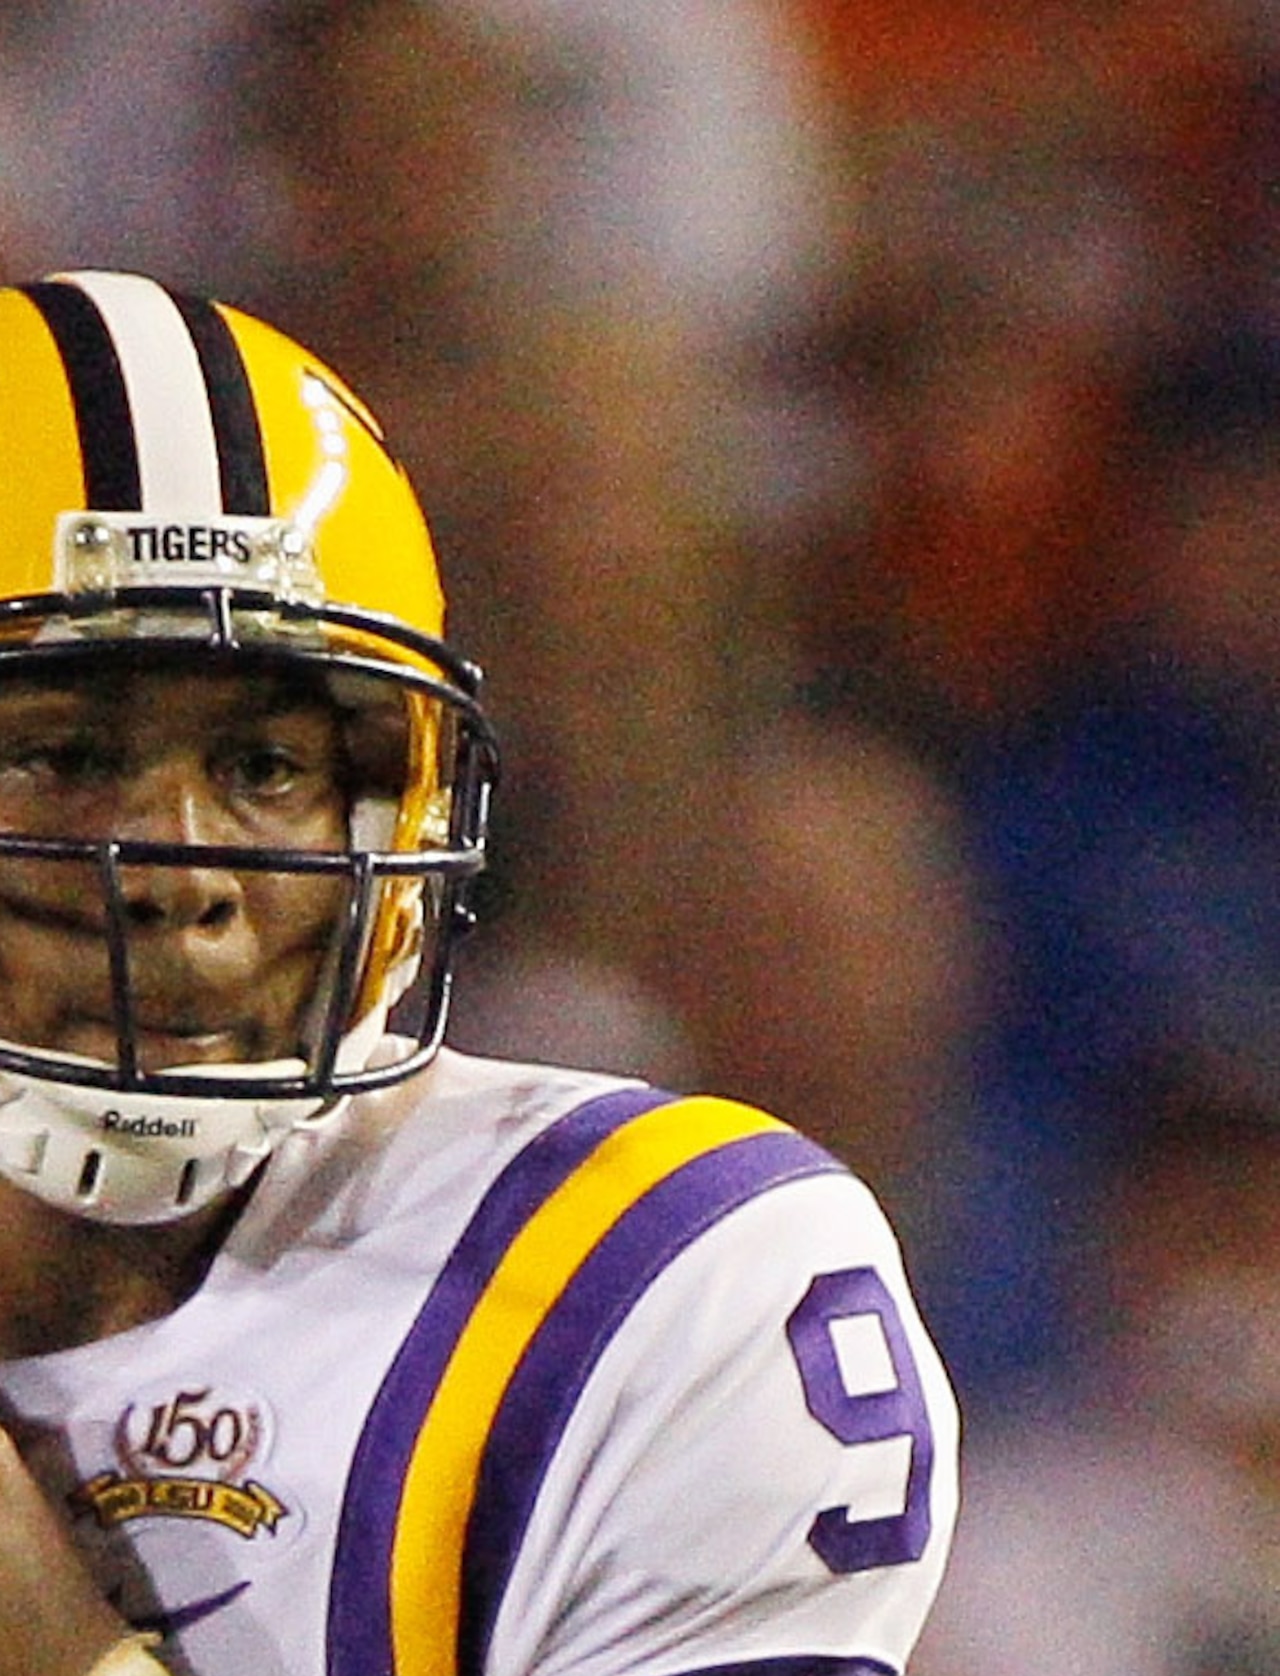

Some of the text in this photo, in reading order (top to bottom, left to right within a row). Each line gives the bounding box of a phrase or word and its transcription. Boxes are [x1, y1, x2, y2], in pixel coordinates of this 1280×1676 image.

[127, 524, 250, 563] TIGERS
[104, 1110, 195, 1137] Riddell
[139, 1385, 242, 1466] 150
[785, 1265, 934, 1575] 9
